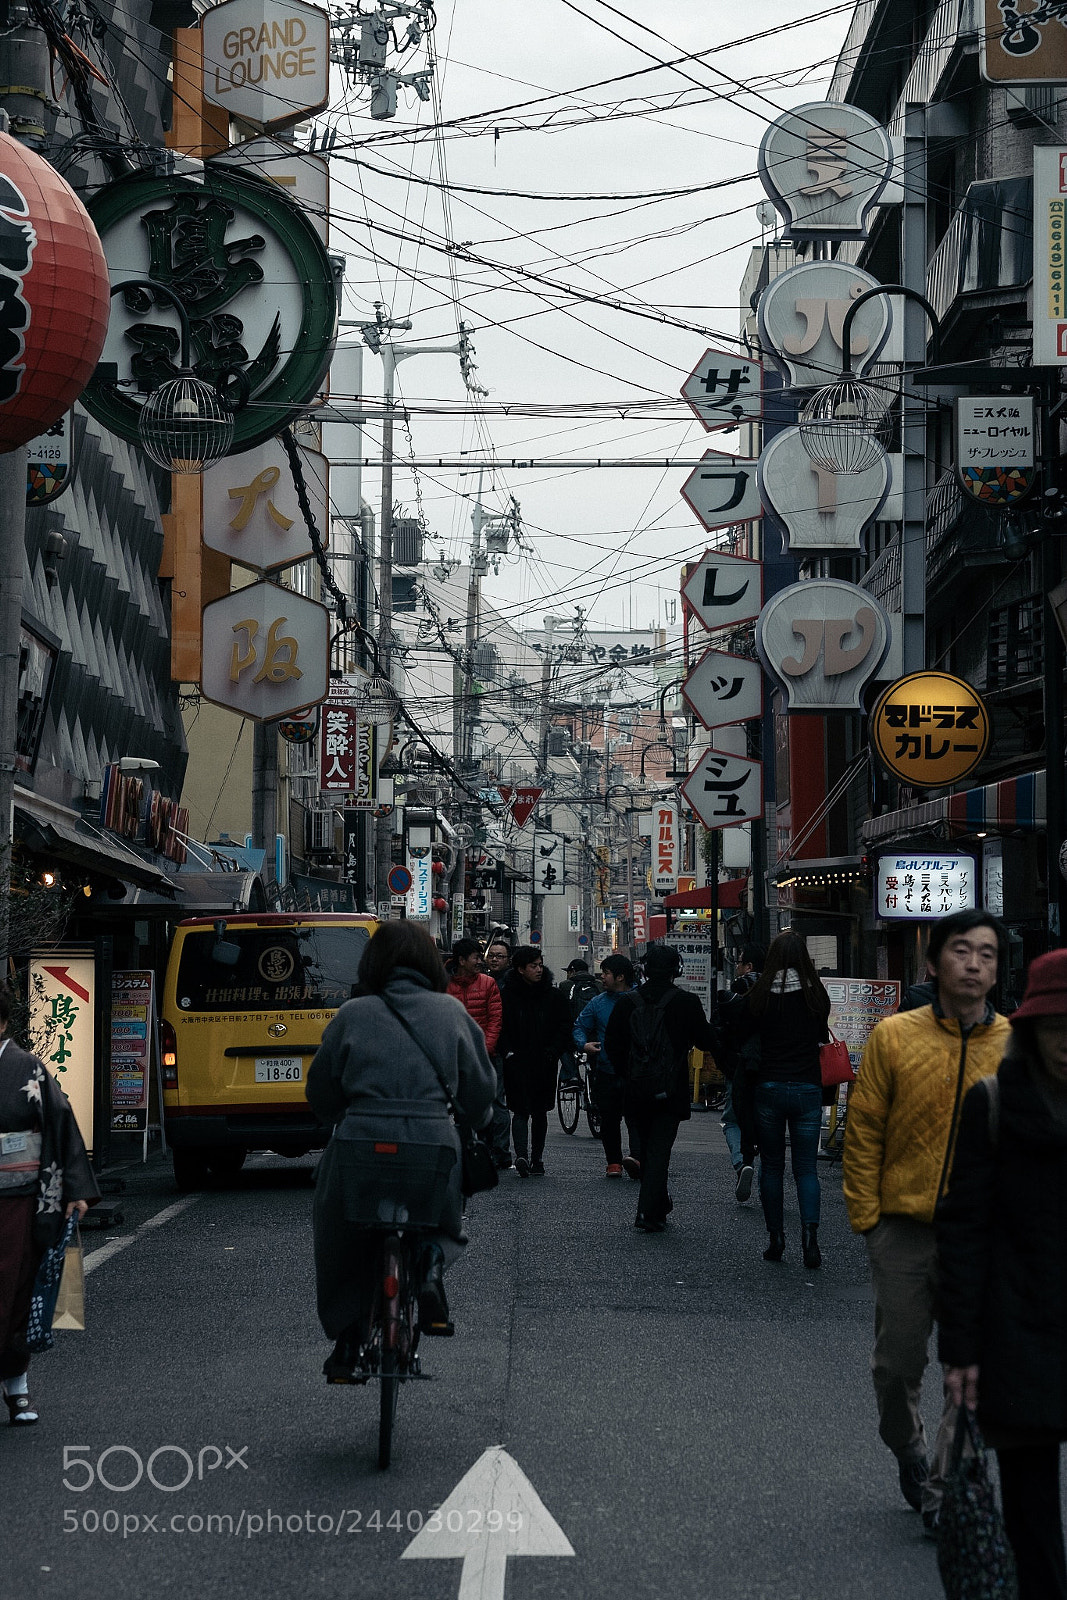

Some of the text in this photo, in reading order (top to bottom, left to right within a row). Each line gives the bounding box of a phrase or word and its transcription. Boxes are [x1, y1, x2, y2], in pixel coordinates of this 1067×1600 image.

[223, 17, 306, 59] GRAND
[214, 46, 316, 95] LOUNGE
[963, 426, 1031, 437] ニューロイヤル
[884, 705, 980, 729] マドラス
[326, 710, 349, 779] 笑酔人
[895, 734, 979, 760] カレー
[658, 809, 675, 874] カルピス
[895, 860, 958, 870] 鳥よしグループ
[885, 876, 899, 908] 受付
[902, 873, 916, 912] 鳥よし
[921, 873, 932, 912] ミス大阪
[937, 872, 953, 912] ミスパール
[850, 984, 897, 996] ラウンジ
[290, 1012, 305, 1020] TEL
[267, 1067, 300, 1080] 18-60
